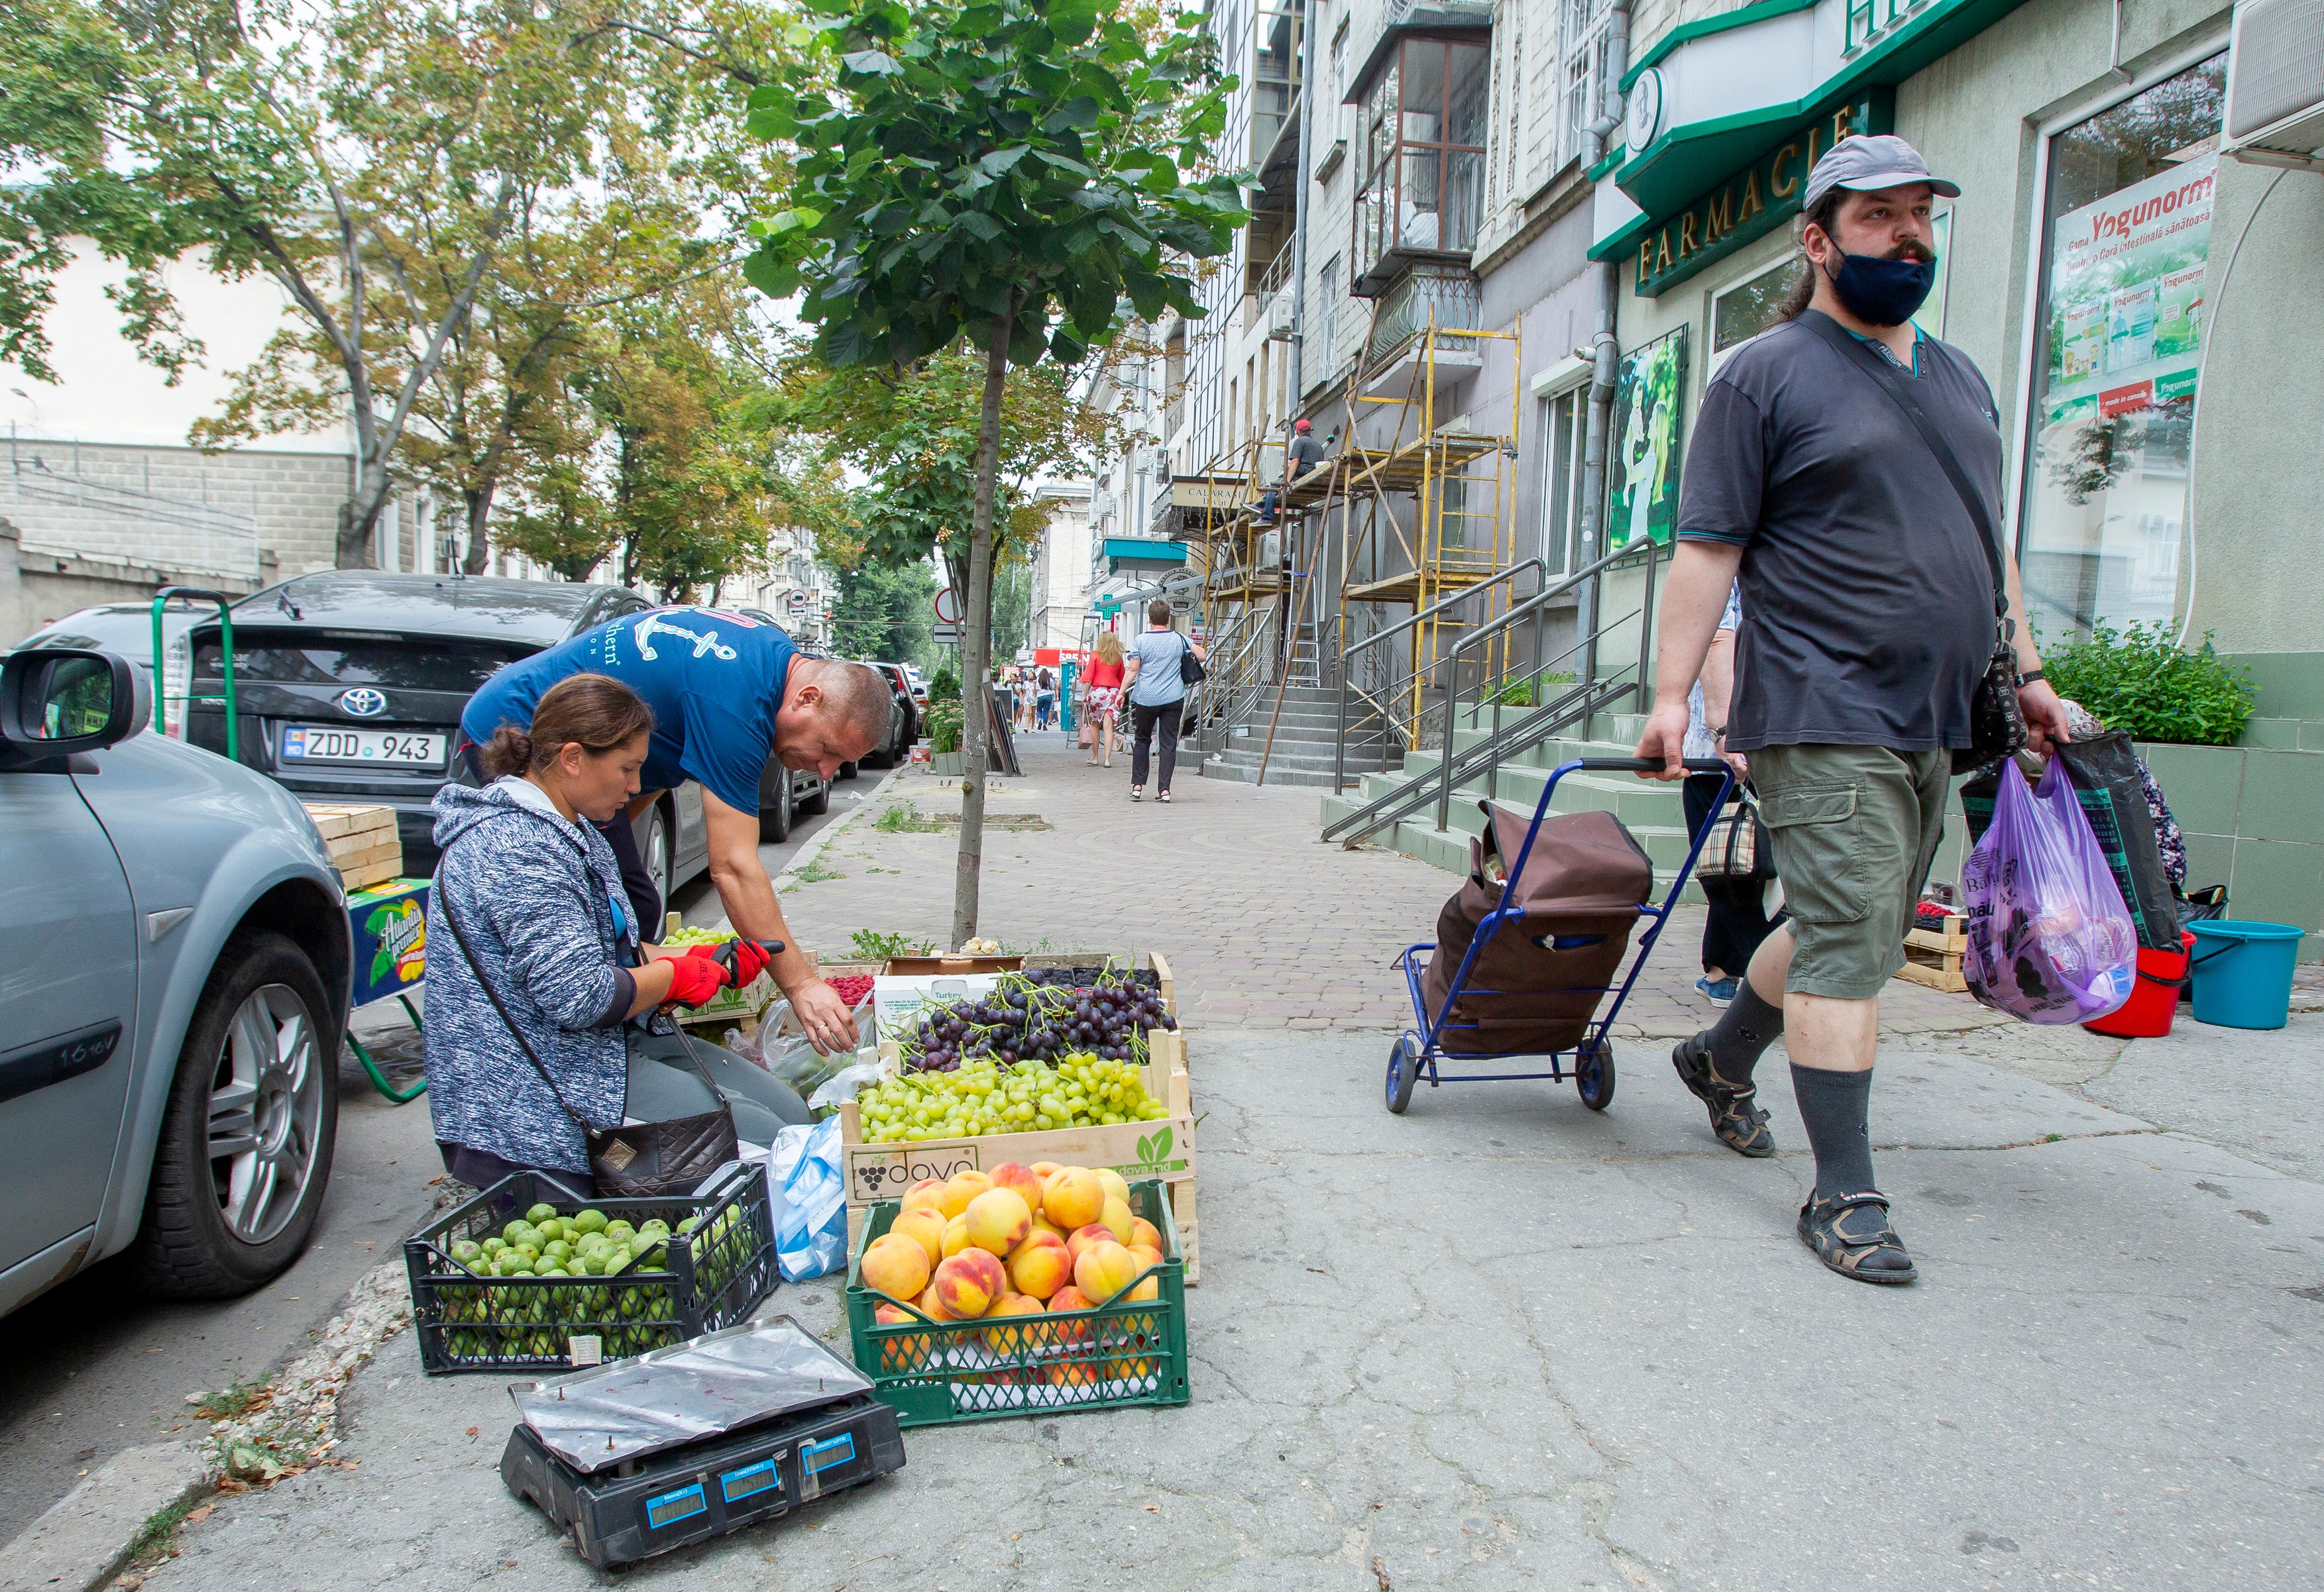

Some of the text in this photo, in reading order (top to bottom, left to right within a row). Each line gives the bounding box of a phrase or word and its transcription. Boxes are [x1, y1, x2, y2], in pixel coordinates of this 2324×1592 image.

[2069, 175, 2213, 252] Gama Yogunorm
[2093, 254, 2097, 263] o
[2099, 244, 2118, 261] floră
[2119, 226, 2163, 252] intestinală
[2164, 209, 2210, 237] sănătoasă
[2164, 269, 2203, 288] Yogunorm
[2114, 289, 2150, 307] Yogunorm
[2067, 305, 2101, 322] Yogunorm
[2105, 398, 2120, 406] made
[2127, 391, 2147, 402] canada
[1203, 498, 1226, 506] Dvin
[287, 745, 302, 755] MD
[308, 733, 431, 761] ZDD 943
[380, 906, 421, 953] Atlantis
[391, 926, 420, 963] premier
[1115, 1161, 1171, 1176] dova.md
